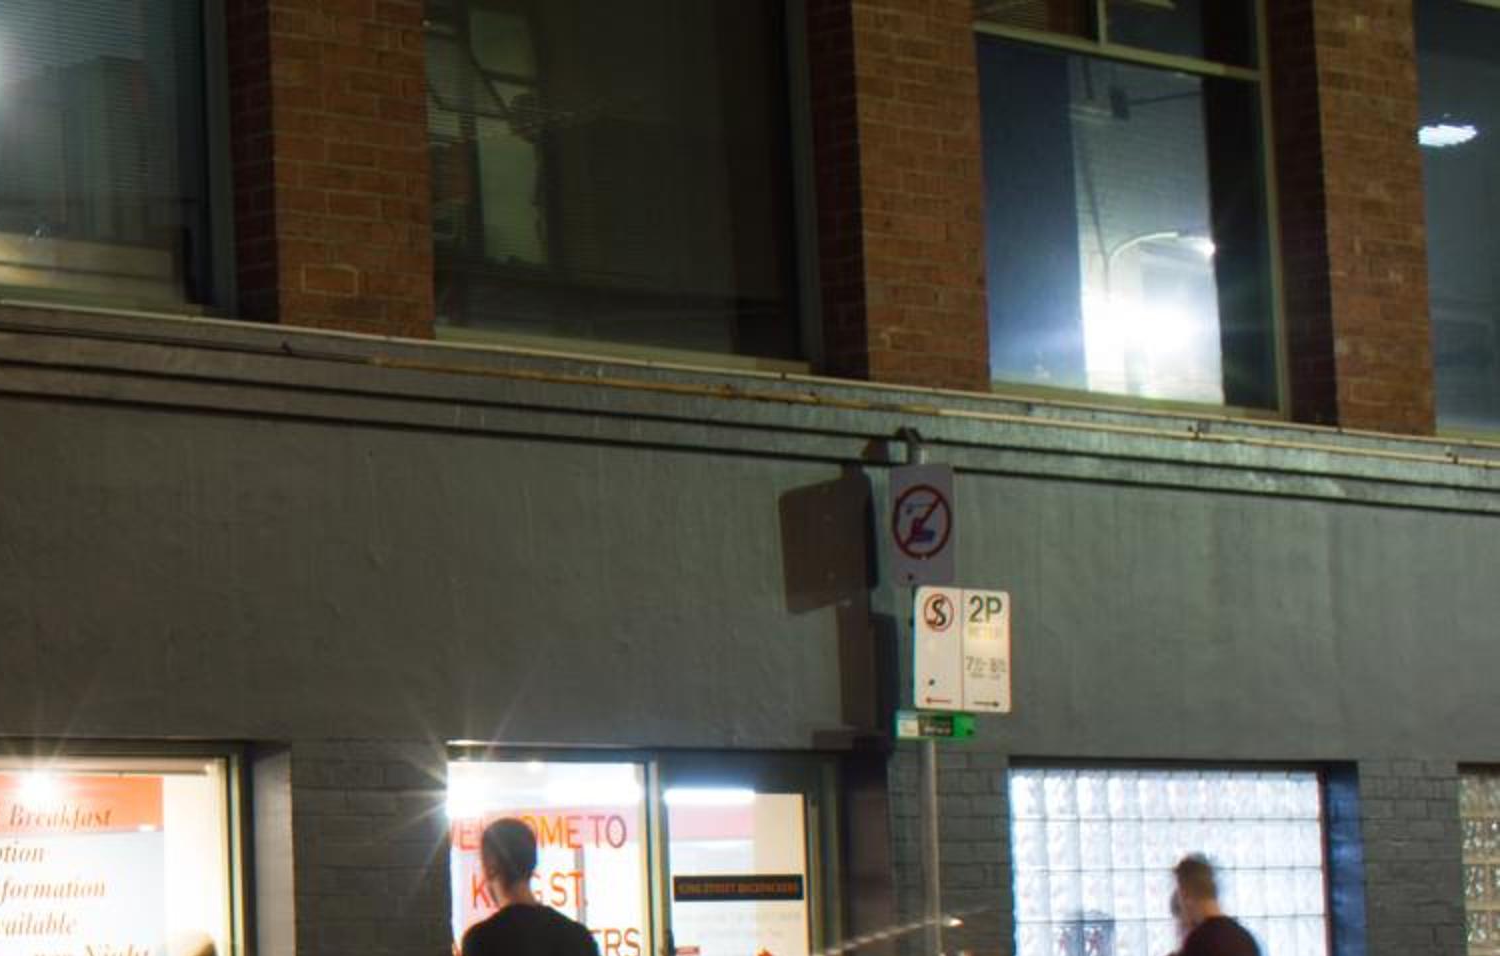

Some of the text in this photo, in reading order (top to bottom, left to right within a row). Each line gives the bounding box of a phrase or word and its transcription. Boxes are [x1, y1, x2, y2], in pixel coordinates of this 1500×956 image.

[969, 595, 1002, 624] 2P
[9, 804, 113, 829] Breakfast
[588, 815, 627, 849] TO
